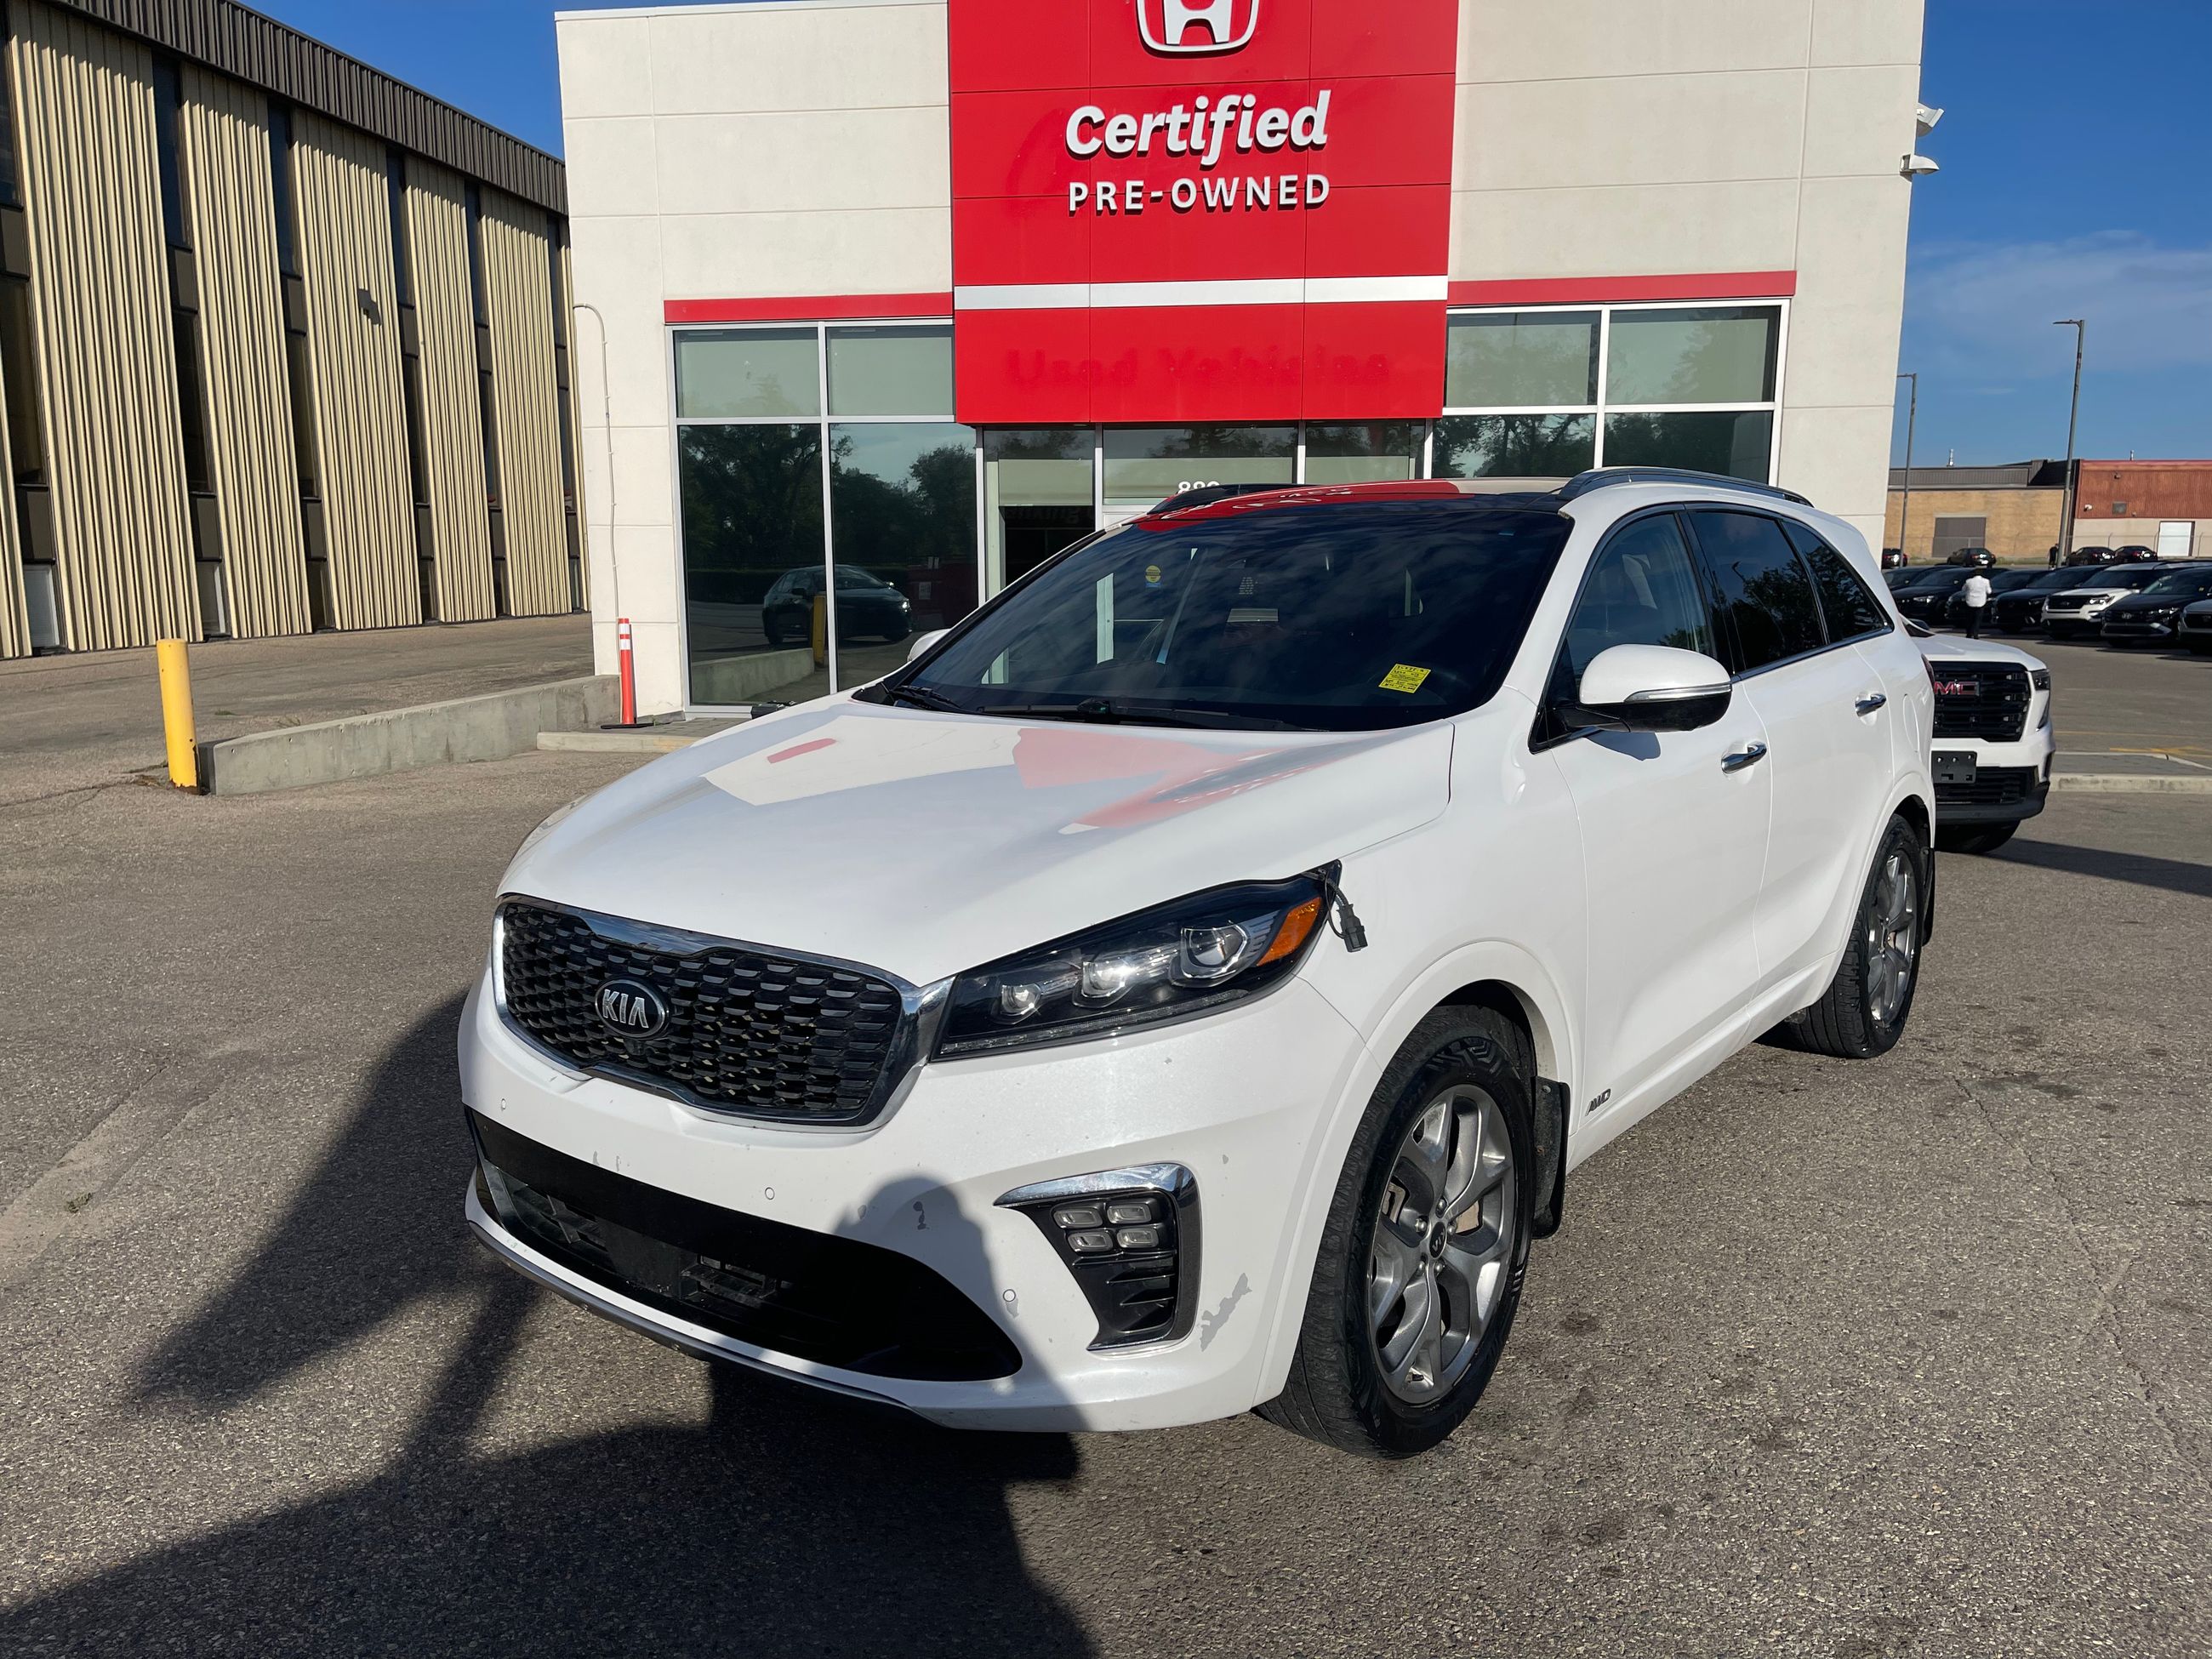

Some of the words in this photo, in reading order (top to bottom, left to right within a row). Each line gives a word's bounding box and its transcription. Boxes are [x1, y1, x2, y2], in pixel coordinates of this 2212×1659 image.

[1066, 89, 1331, 167] Certified
[1069, 174, 1330, 212] PRE-OWNED
[1934, 681, 1980, 696] MC
[602, 989, 649, 1028] KIA
